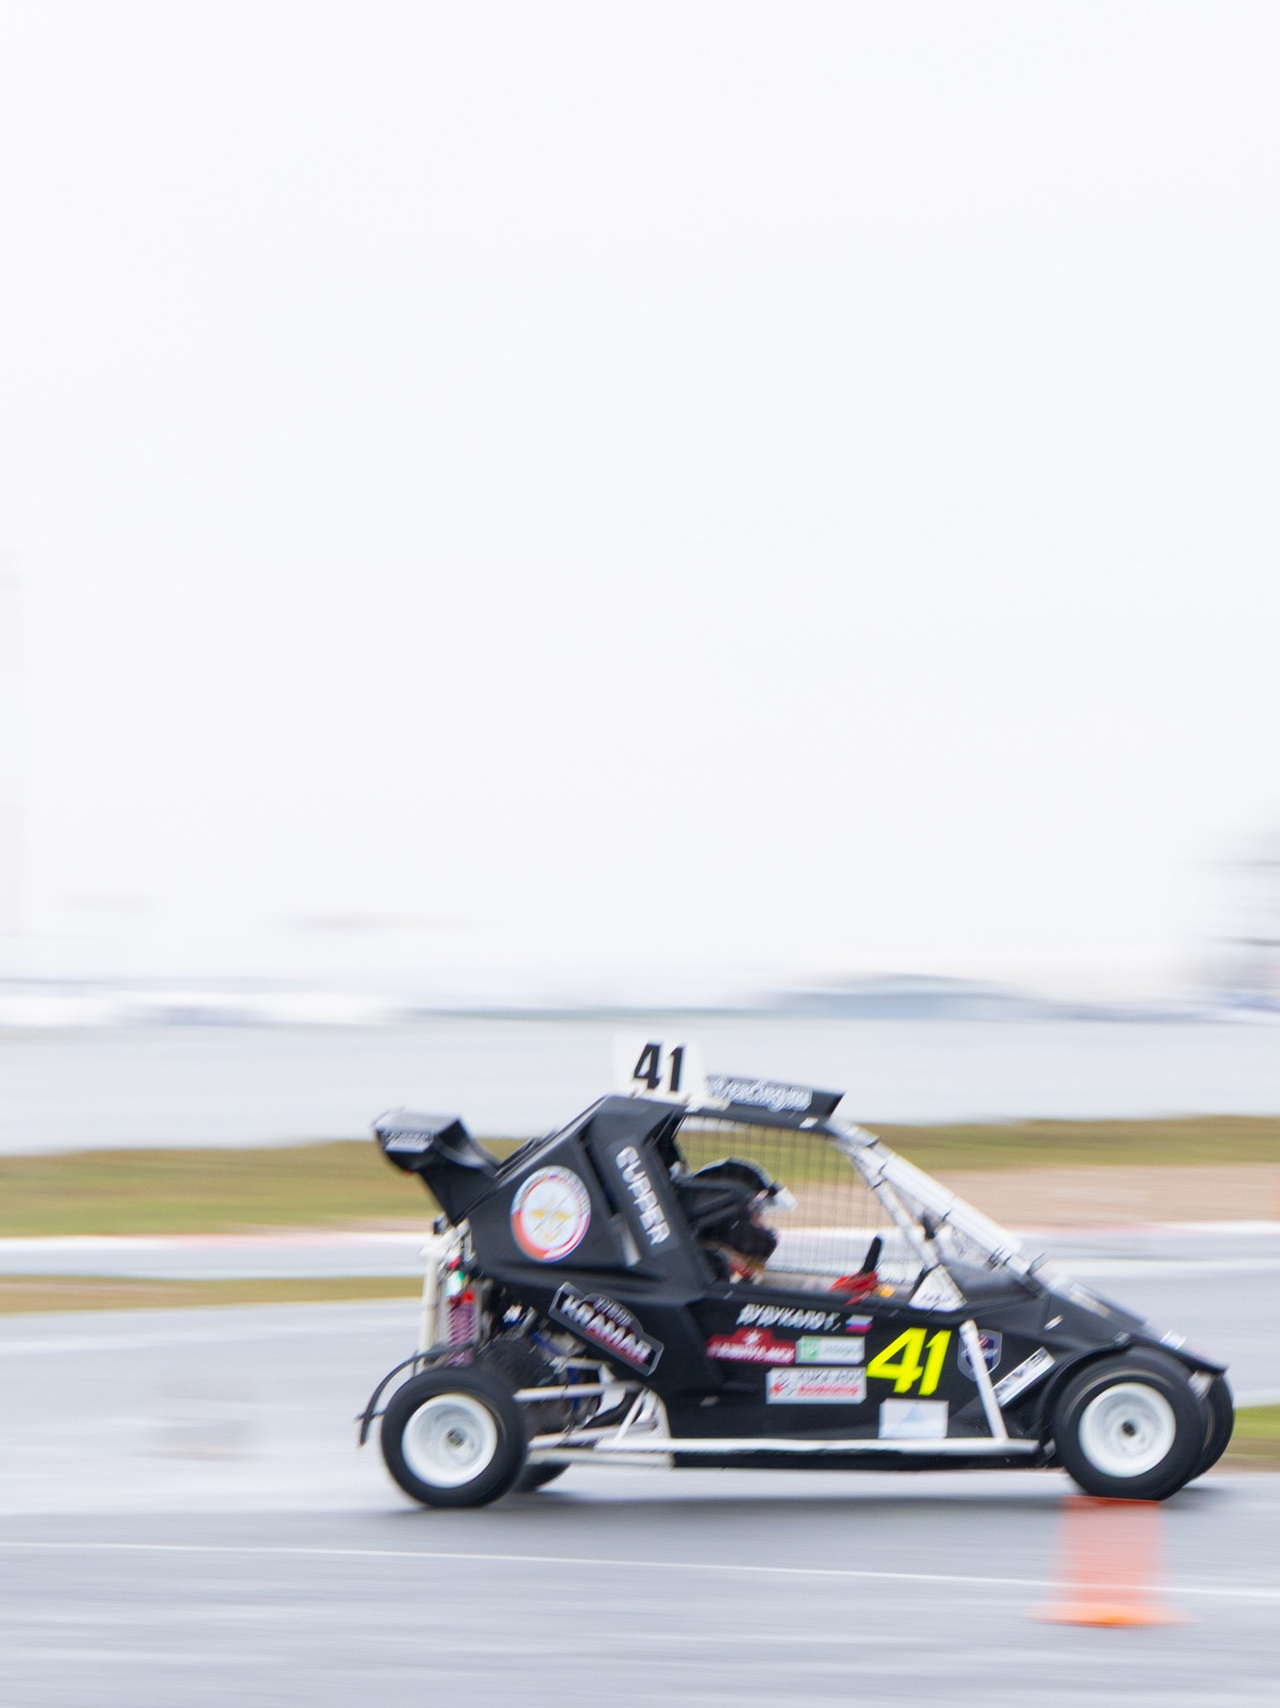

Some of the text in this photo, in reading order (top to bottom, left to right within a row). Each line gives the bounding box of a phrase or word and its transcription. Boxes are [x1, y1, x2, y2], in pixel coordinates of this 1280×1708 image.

[633, 1042, 684, 1091] 41
[615, 1145, 671, 1246] CUPPER
[865, 1327, 952, 1396] 41
